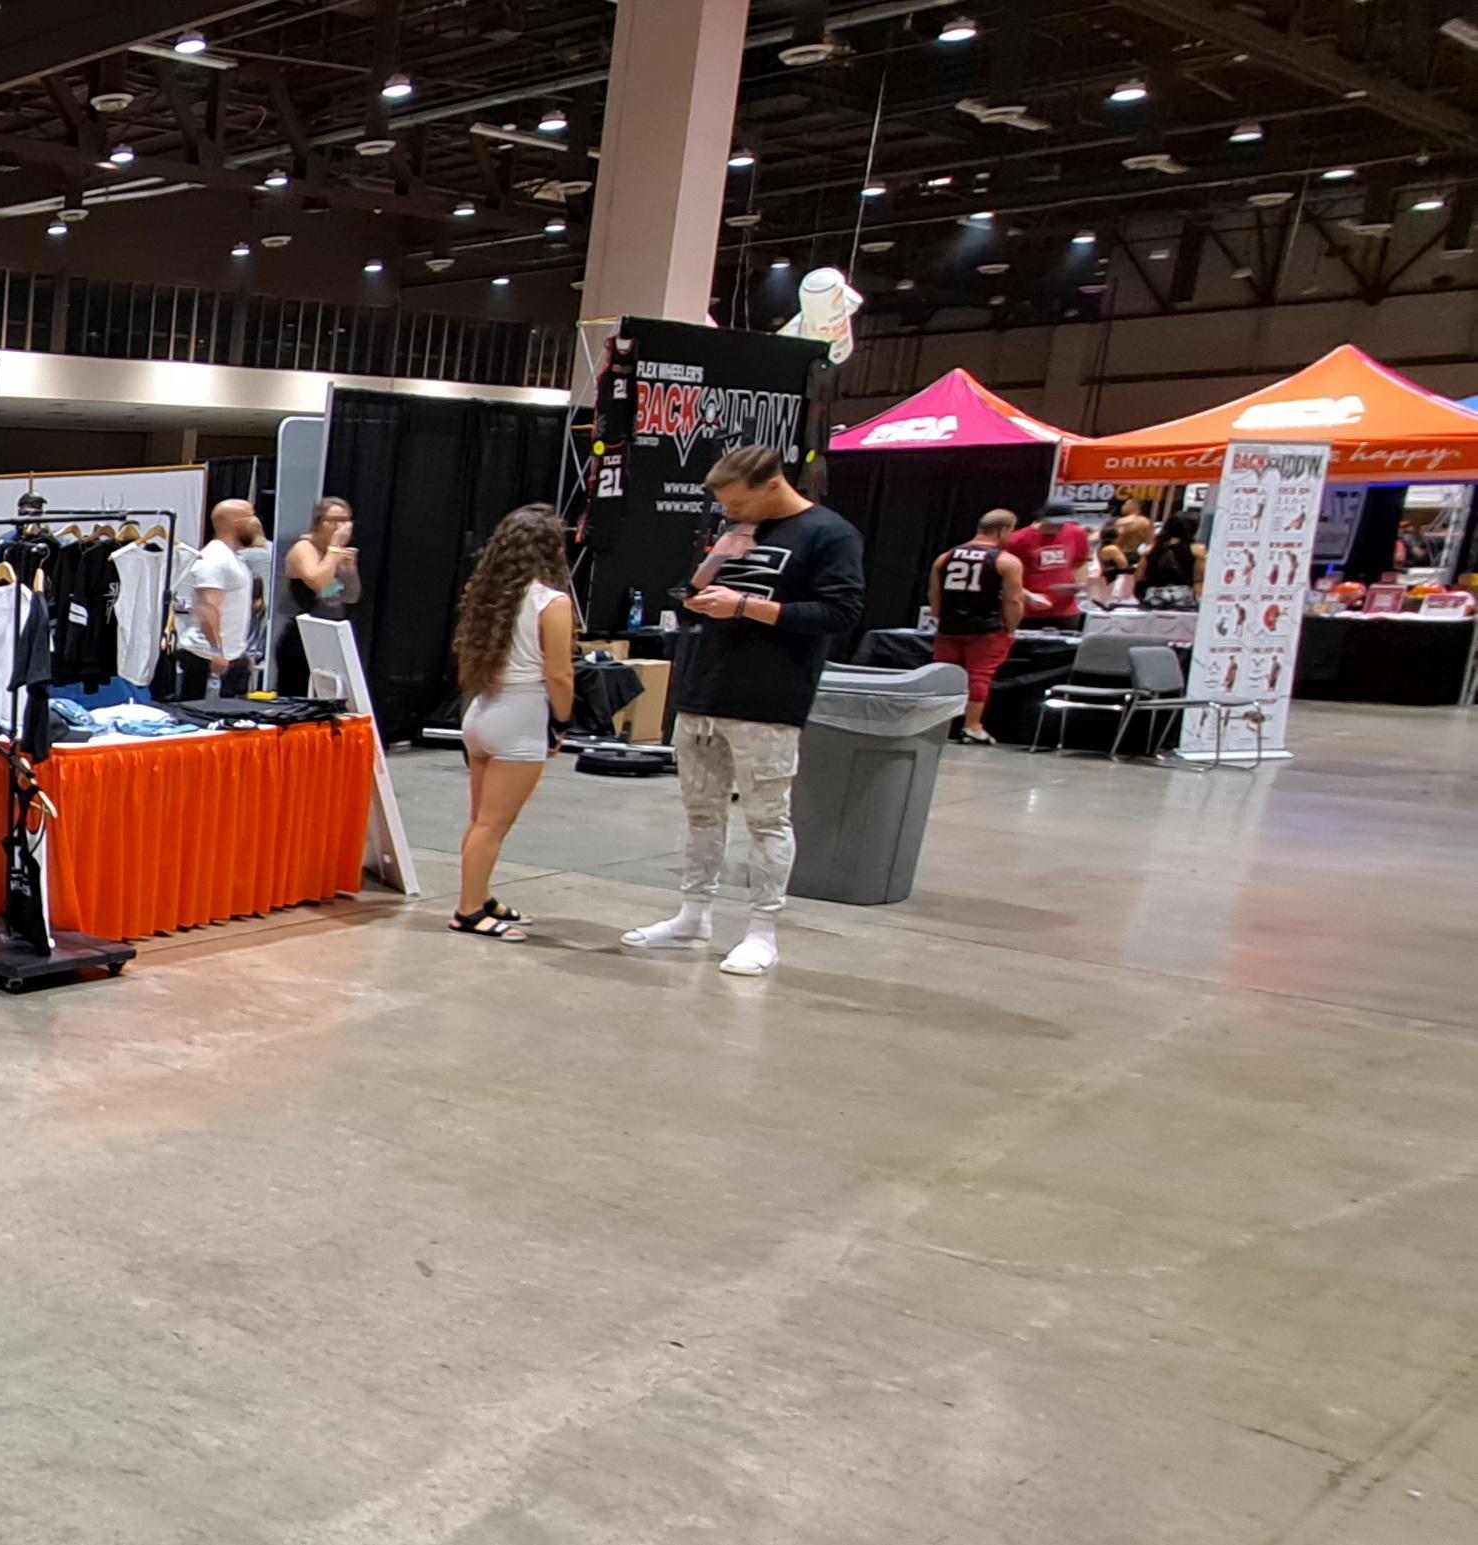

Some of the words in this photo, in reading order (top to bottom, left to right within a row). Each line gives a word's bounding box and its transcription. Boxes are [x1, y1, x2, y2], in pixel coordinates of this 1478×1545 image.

[636, 380, 702, 436] BACK
[1104, 456, 1177, 469] DRINK
[597, 467, 623, 498] 21
[944, 561, 983, 592] 21
